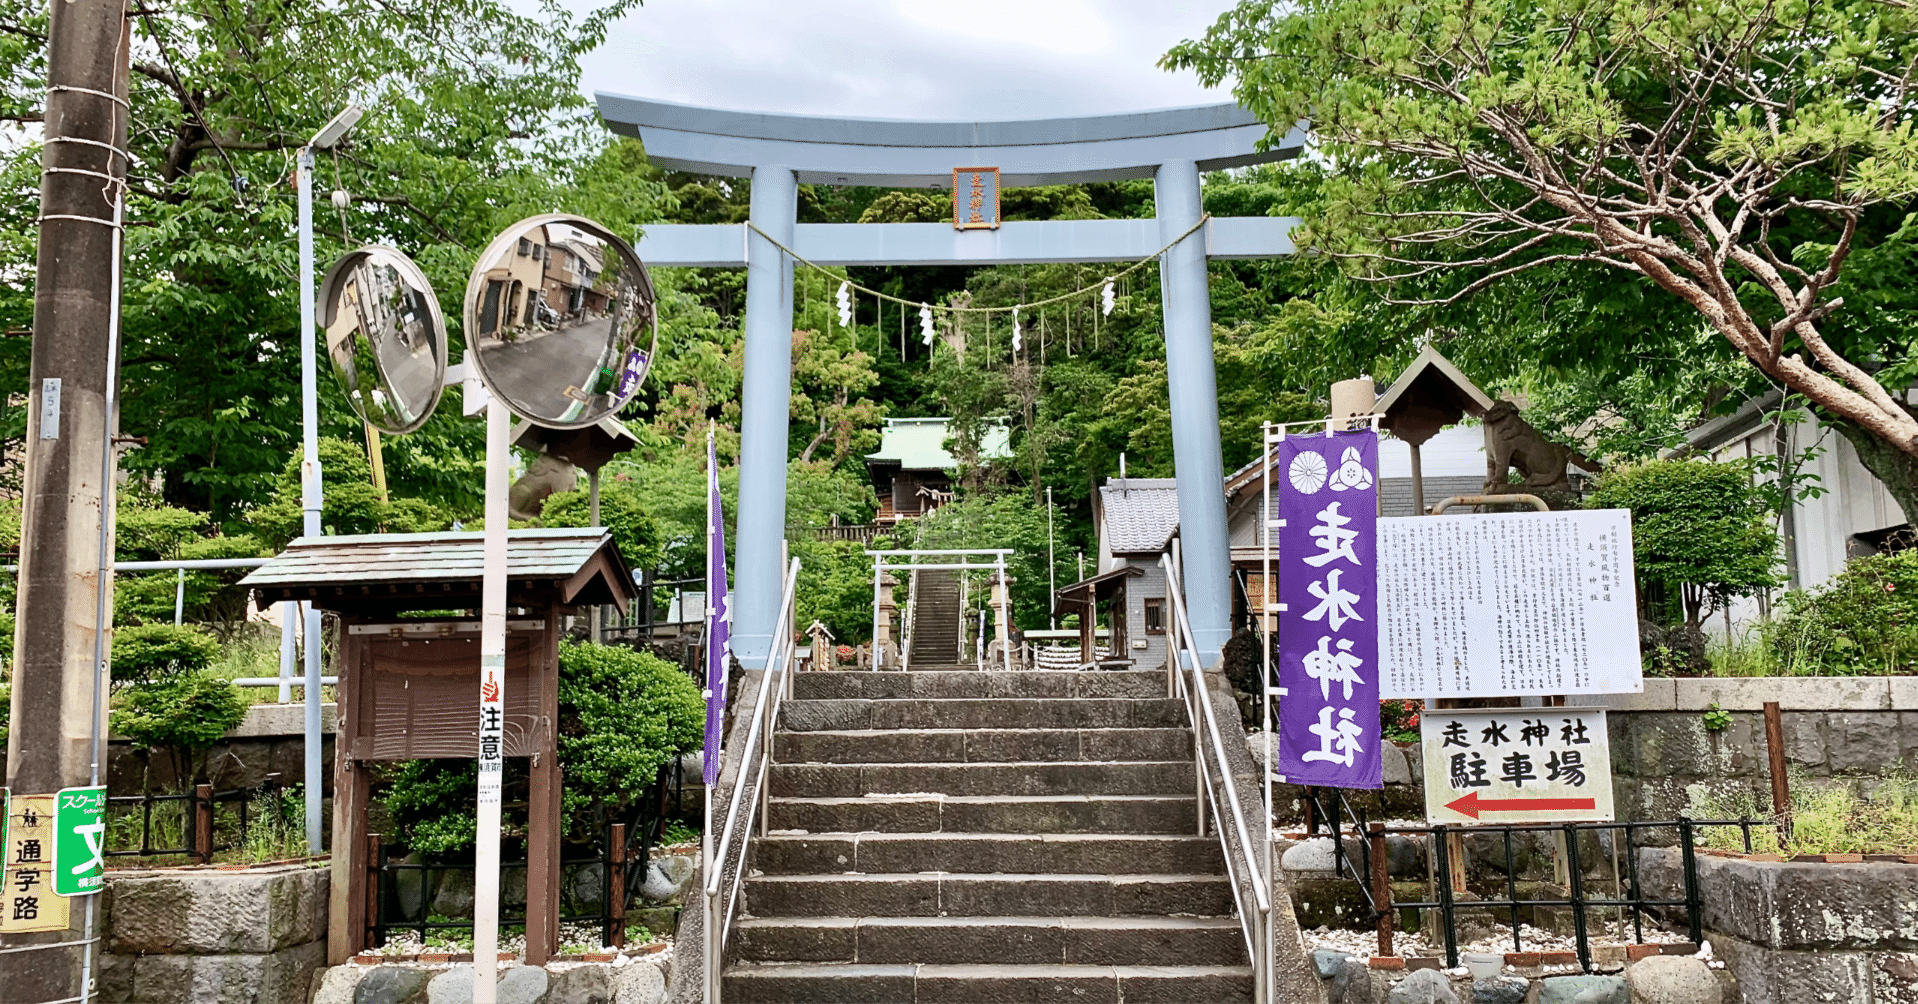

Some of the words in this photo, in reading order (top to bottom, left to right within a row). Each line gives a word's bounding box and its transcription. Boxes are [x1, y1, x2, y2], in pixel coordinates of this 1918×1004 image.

[1586, 541, 1599, 602] 走水神社
[1599, 533, 1612, 602] 横須賀風物百選
[481, 706, 500, 760] 注意
[1442, 718, 1590, 748] 走水神社
[1450, 750, 1586, 788] 駐車場
[13, 839, 42, 920] 通学路
